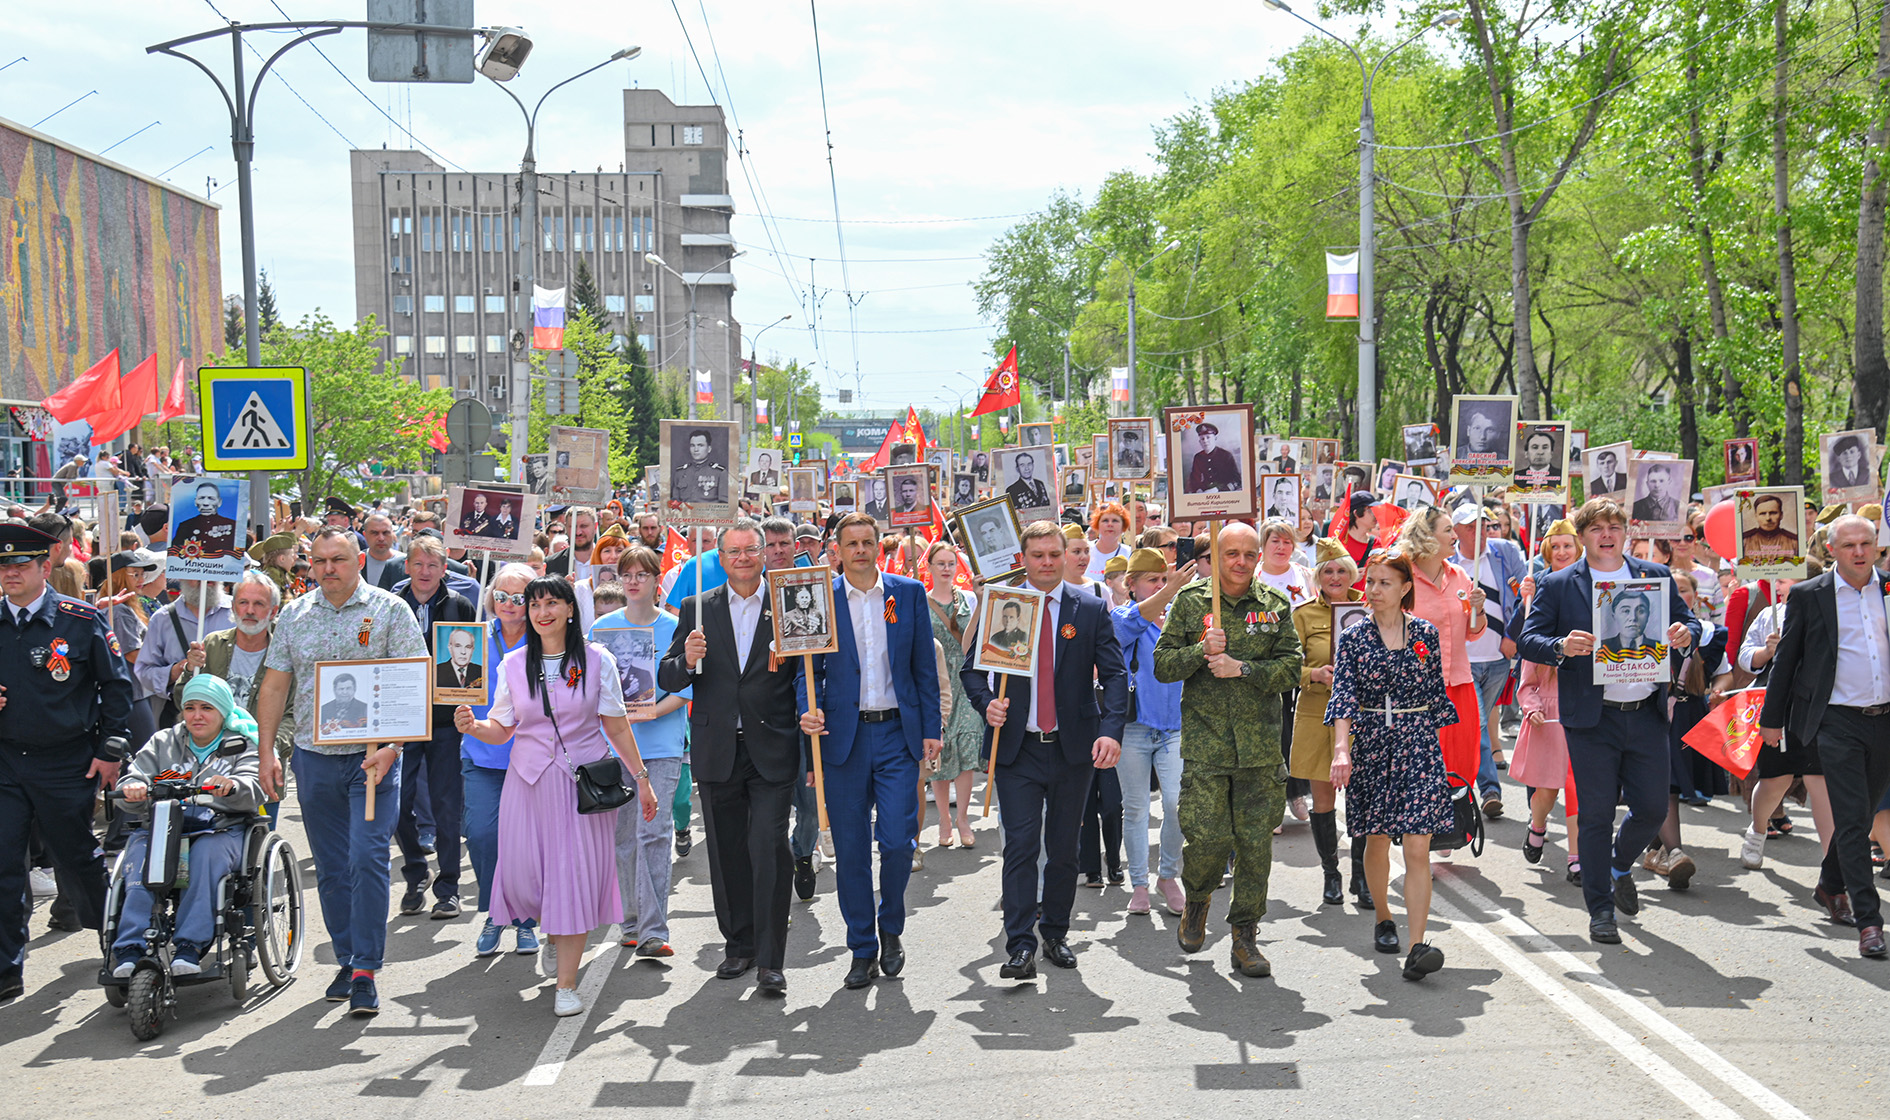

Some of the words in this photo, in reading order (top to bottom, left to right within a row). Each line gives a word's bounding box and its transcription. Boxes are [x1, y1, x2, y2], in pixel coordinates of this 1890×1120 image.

[464, 544, 497, 552] БЕССМЕРТНЫЙ
[184, 560, 224, 569] Илюшин
[168, 565, 201, 574] Дмитрий
[202, 568, 239, 576] Иванович
[1606, 661, 1656, 672] ШЕСТАКОВ
